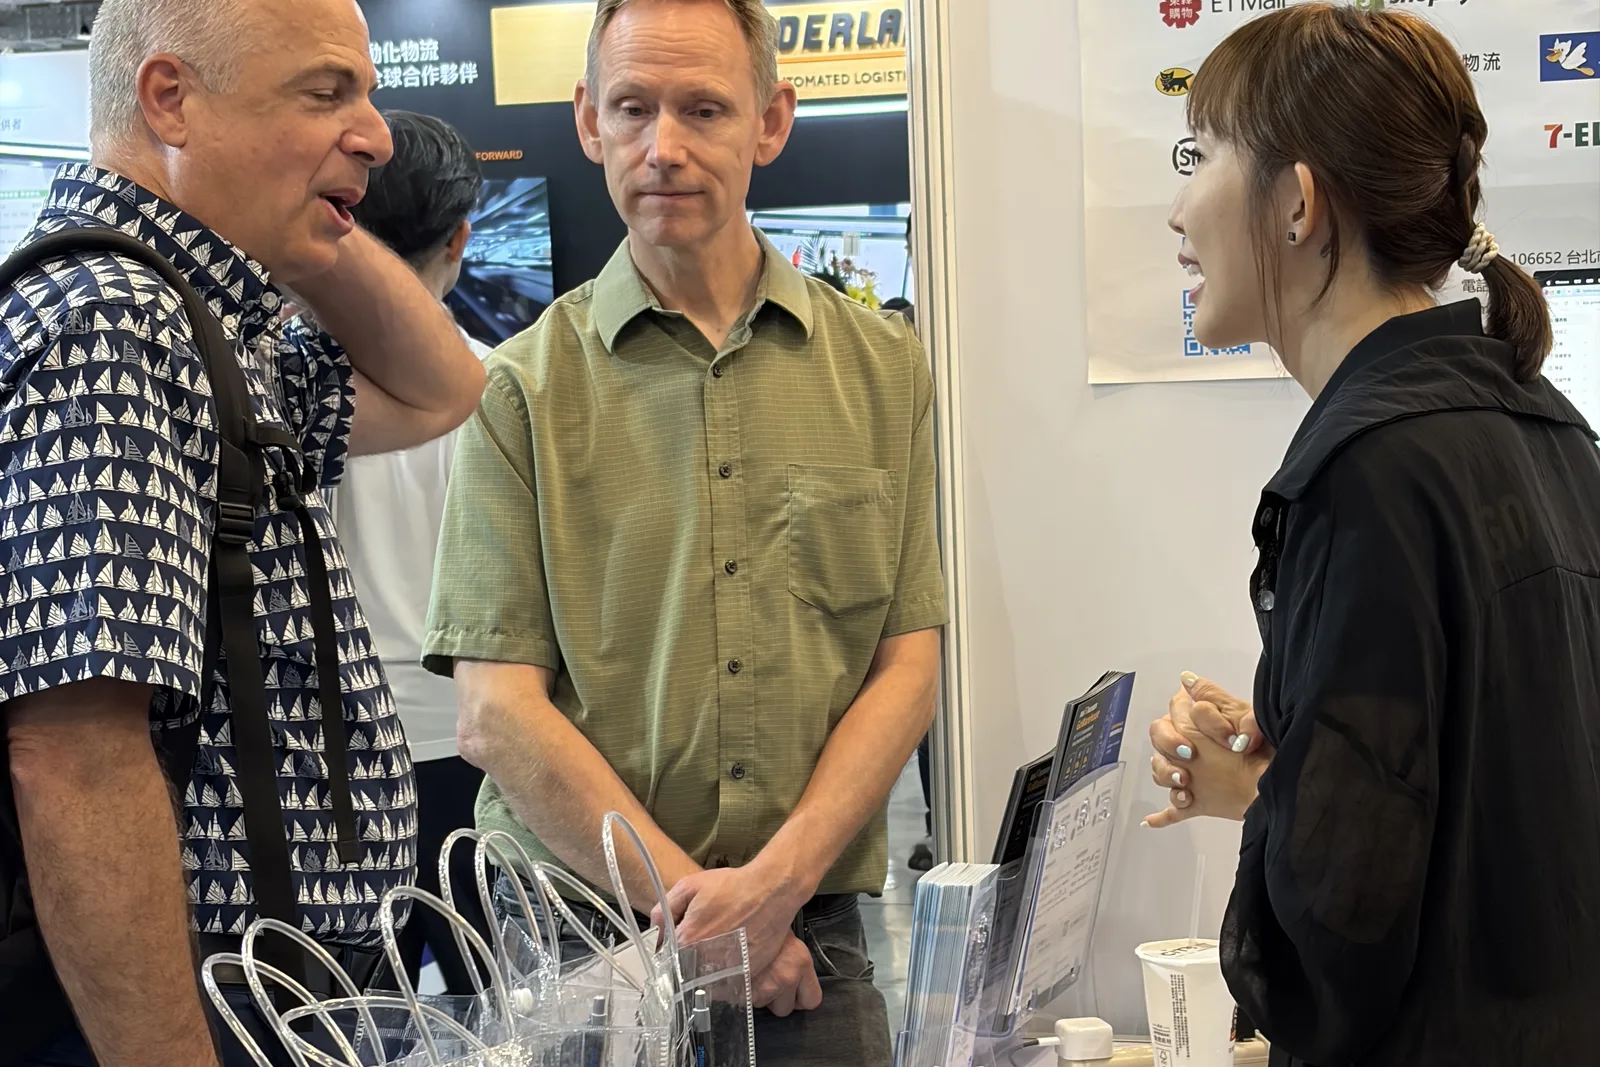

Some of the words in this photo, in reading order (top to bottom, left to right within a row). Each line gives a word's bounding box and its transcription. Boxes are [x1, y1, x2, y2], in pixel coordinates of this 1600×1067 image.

[779, 8, 905, 50] DERLA
[783, 74, 850, 88] TOMATED
[475, 150, 523, 161] FORWARD
[1511, 251, 1562, 266] 106652
[1566, 249, 1600, 265] 台北
